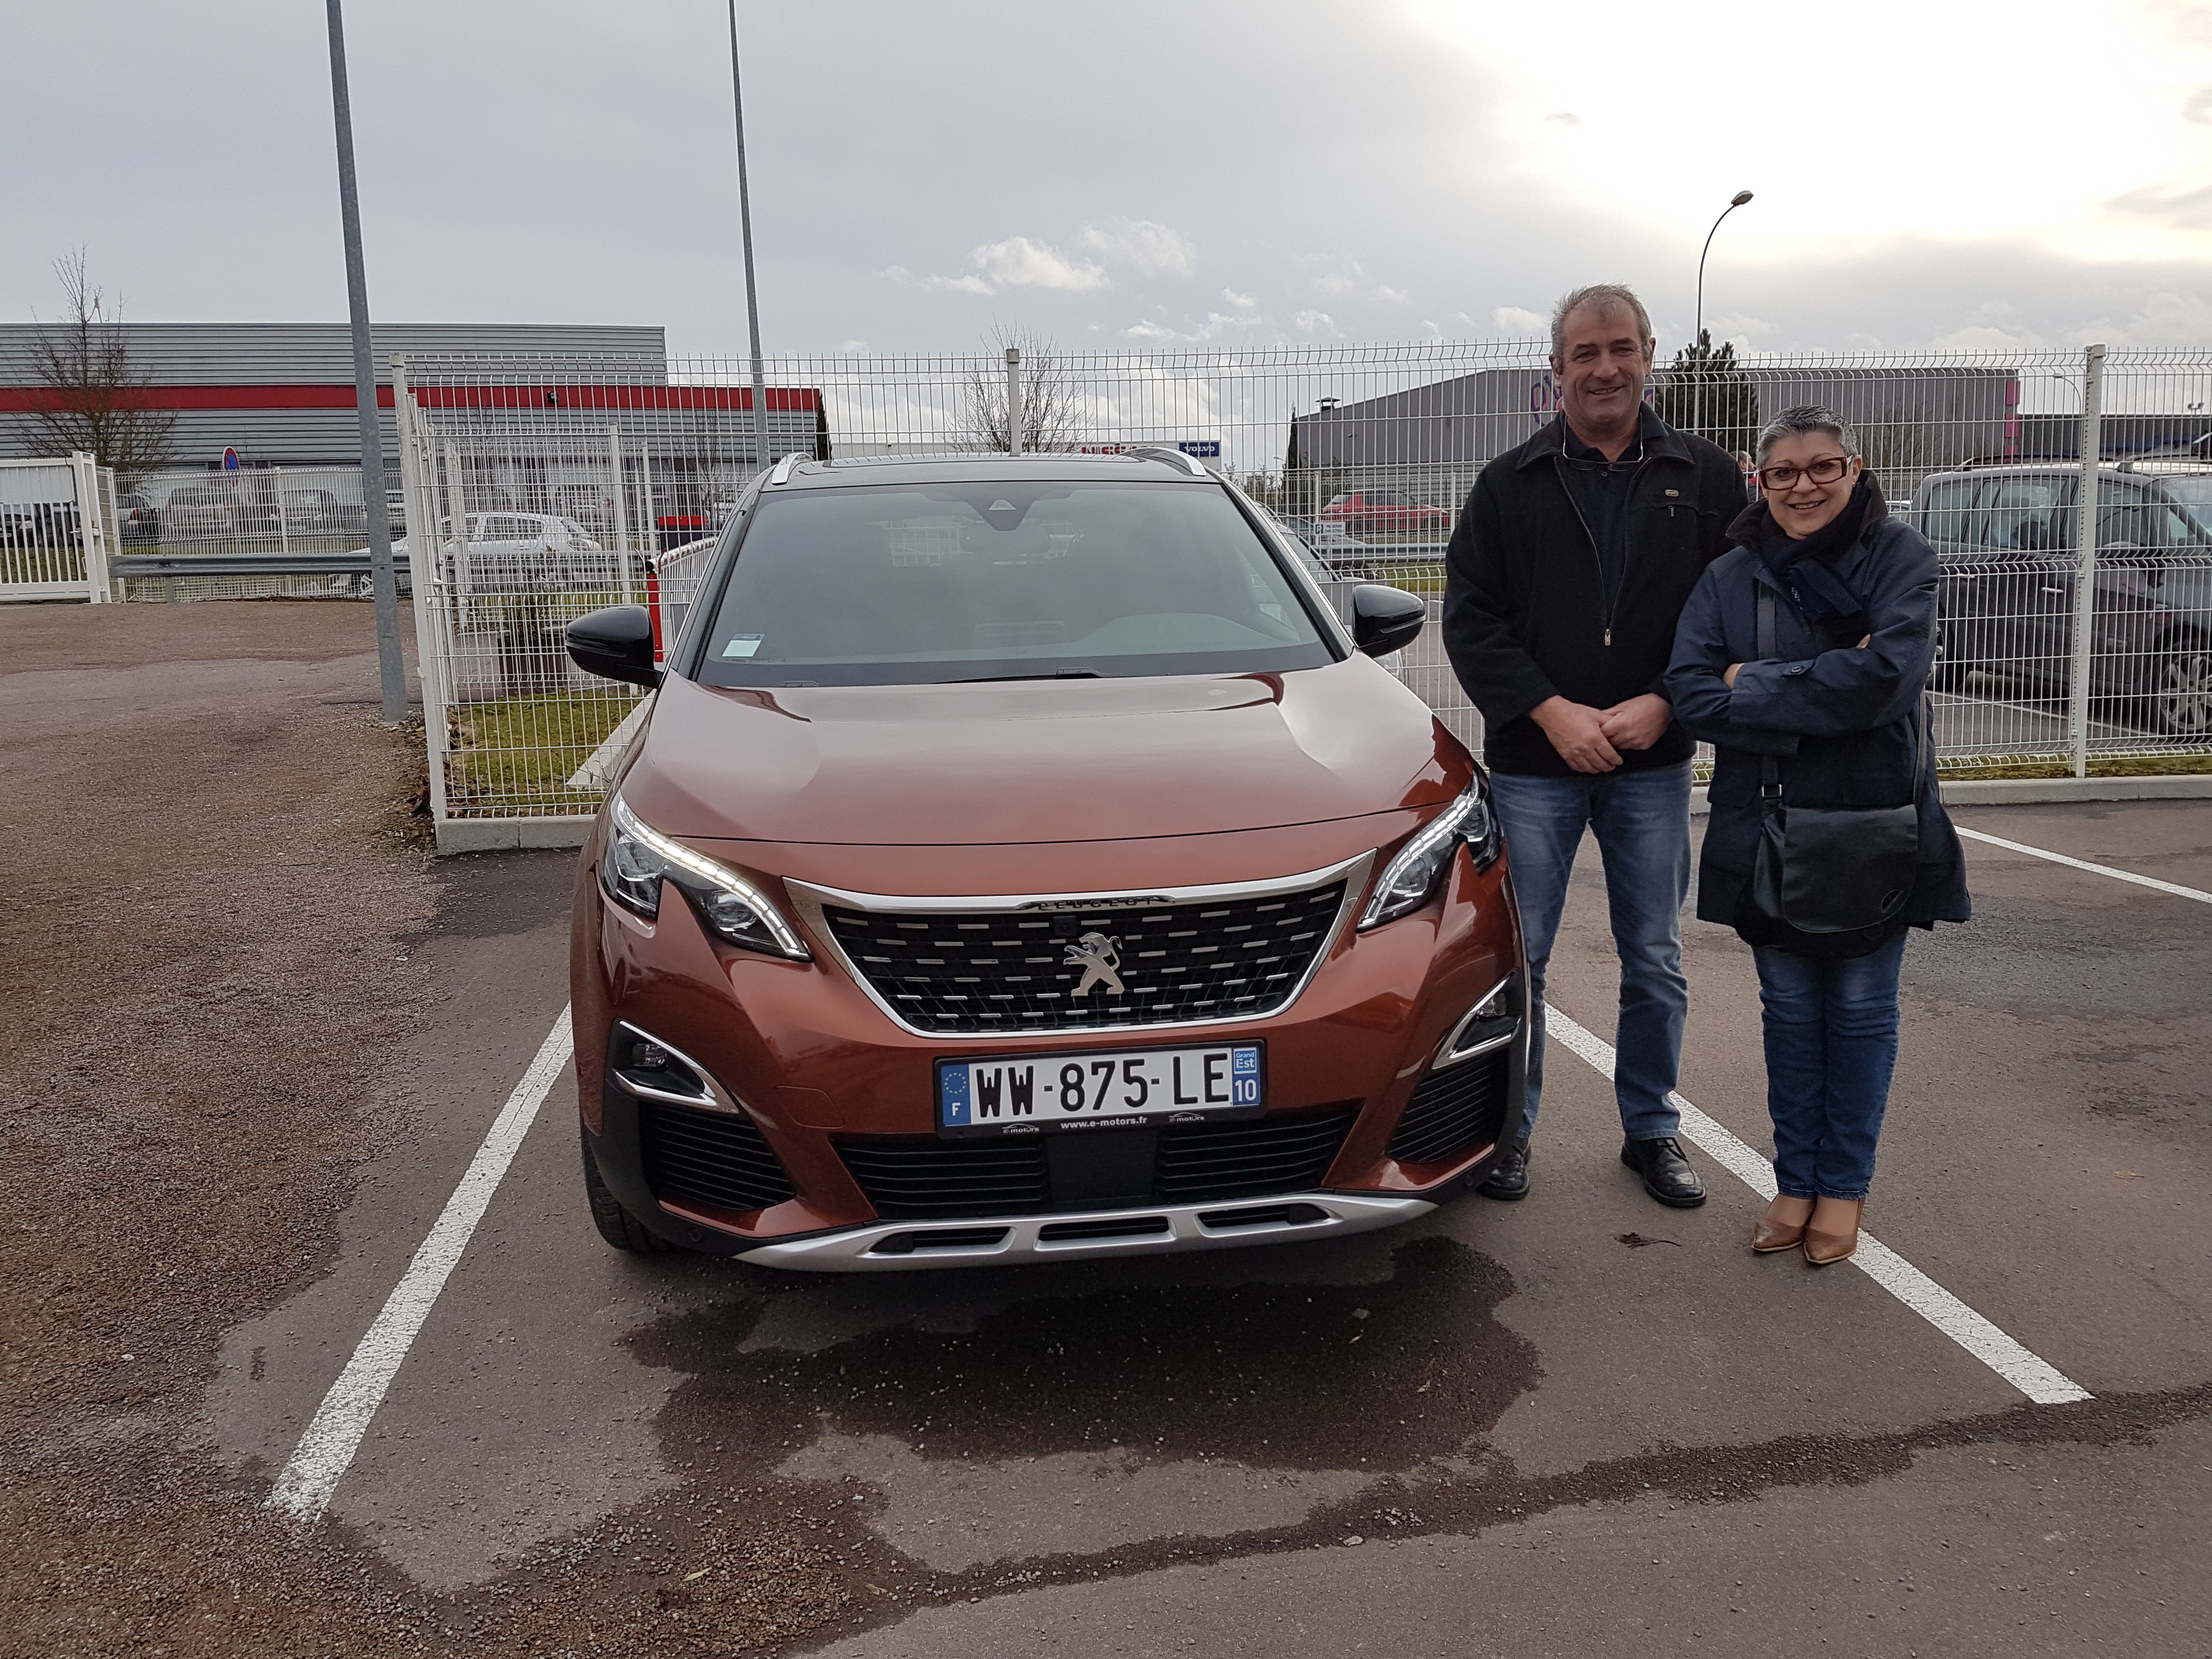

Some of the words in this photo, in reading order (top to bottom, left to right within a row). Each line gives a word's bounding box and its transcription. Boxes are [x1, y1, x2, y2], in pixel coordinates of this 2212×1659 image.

[1038, 897, 1154, 910] PEUGEOT
[1236, 1058, 1255, 1069] Est
[975, 1053, 1229, 1118] WW-875-LE
[1235, 1079, 1256, 1102] 10
[952, 1102, 961, 1116] F
[1060, 1116, 1148, 1129] www.e-motors.fr
